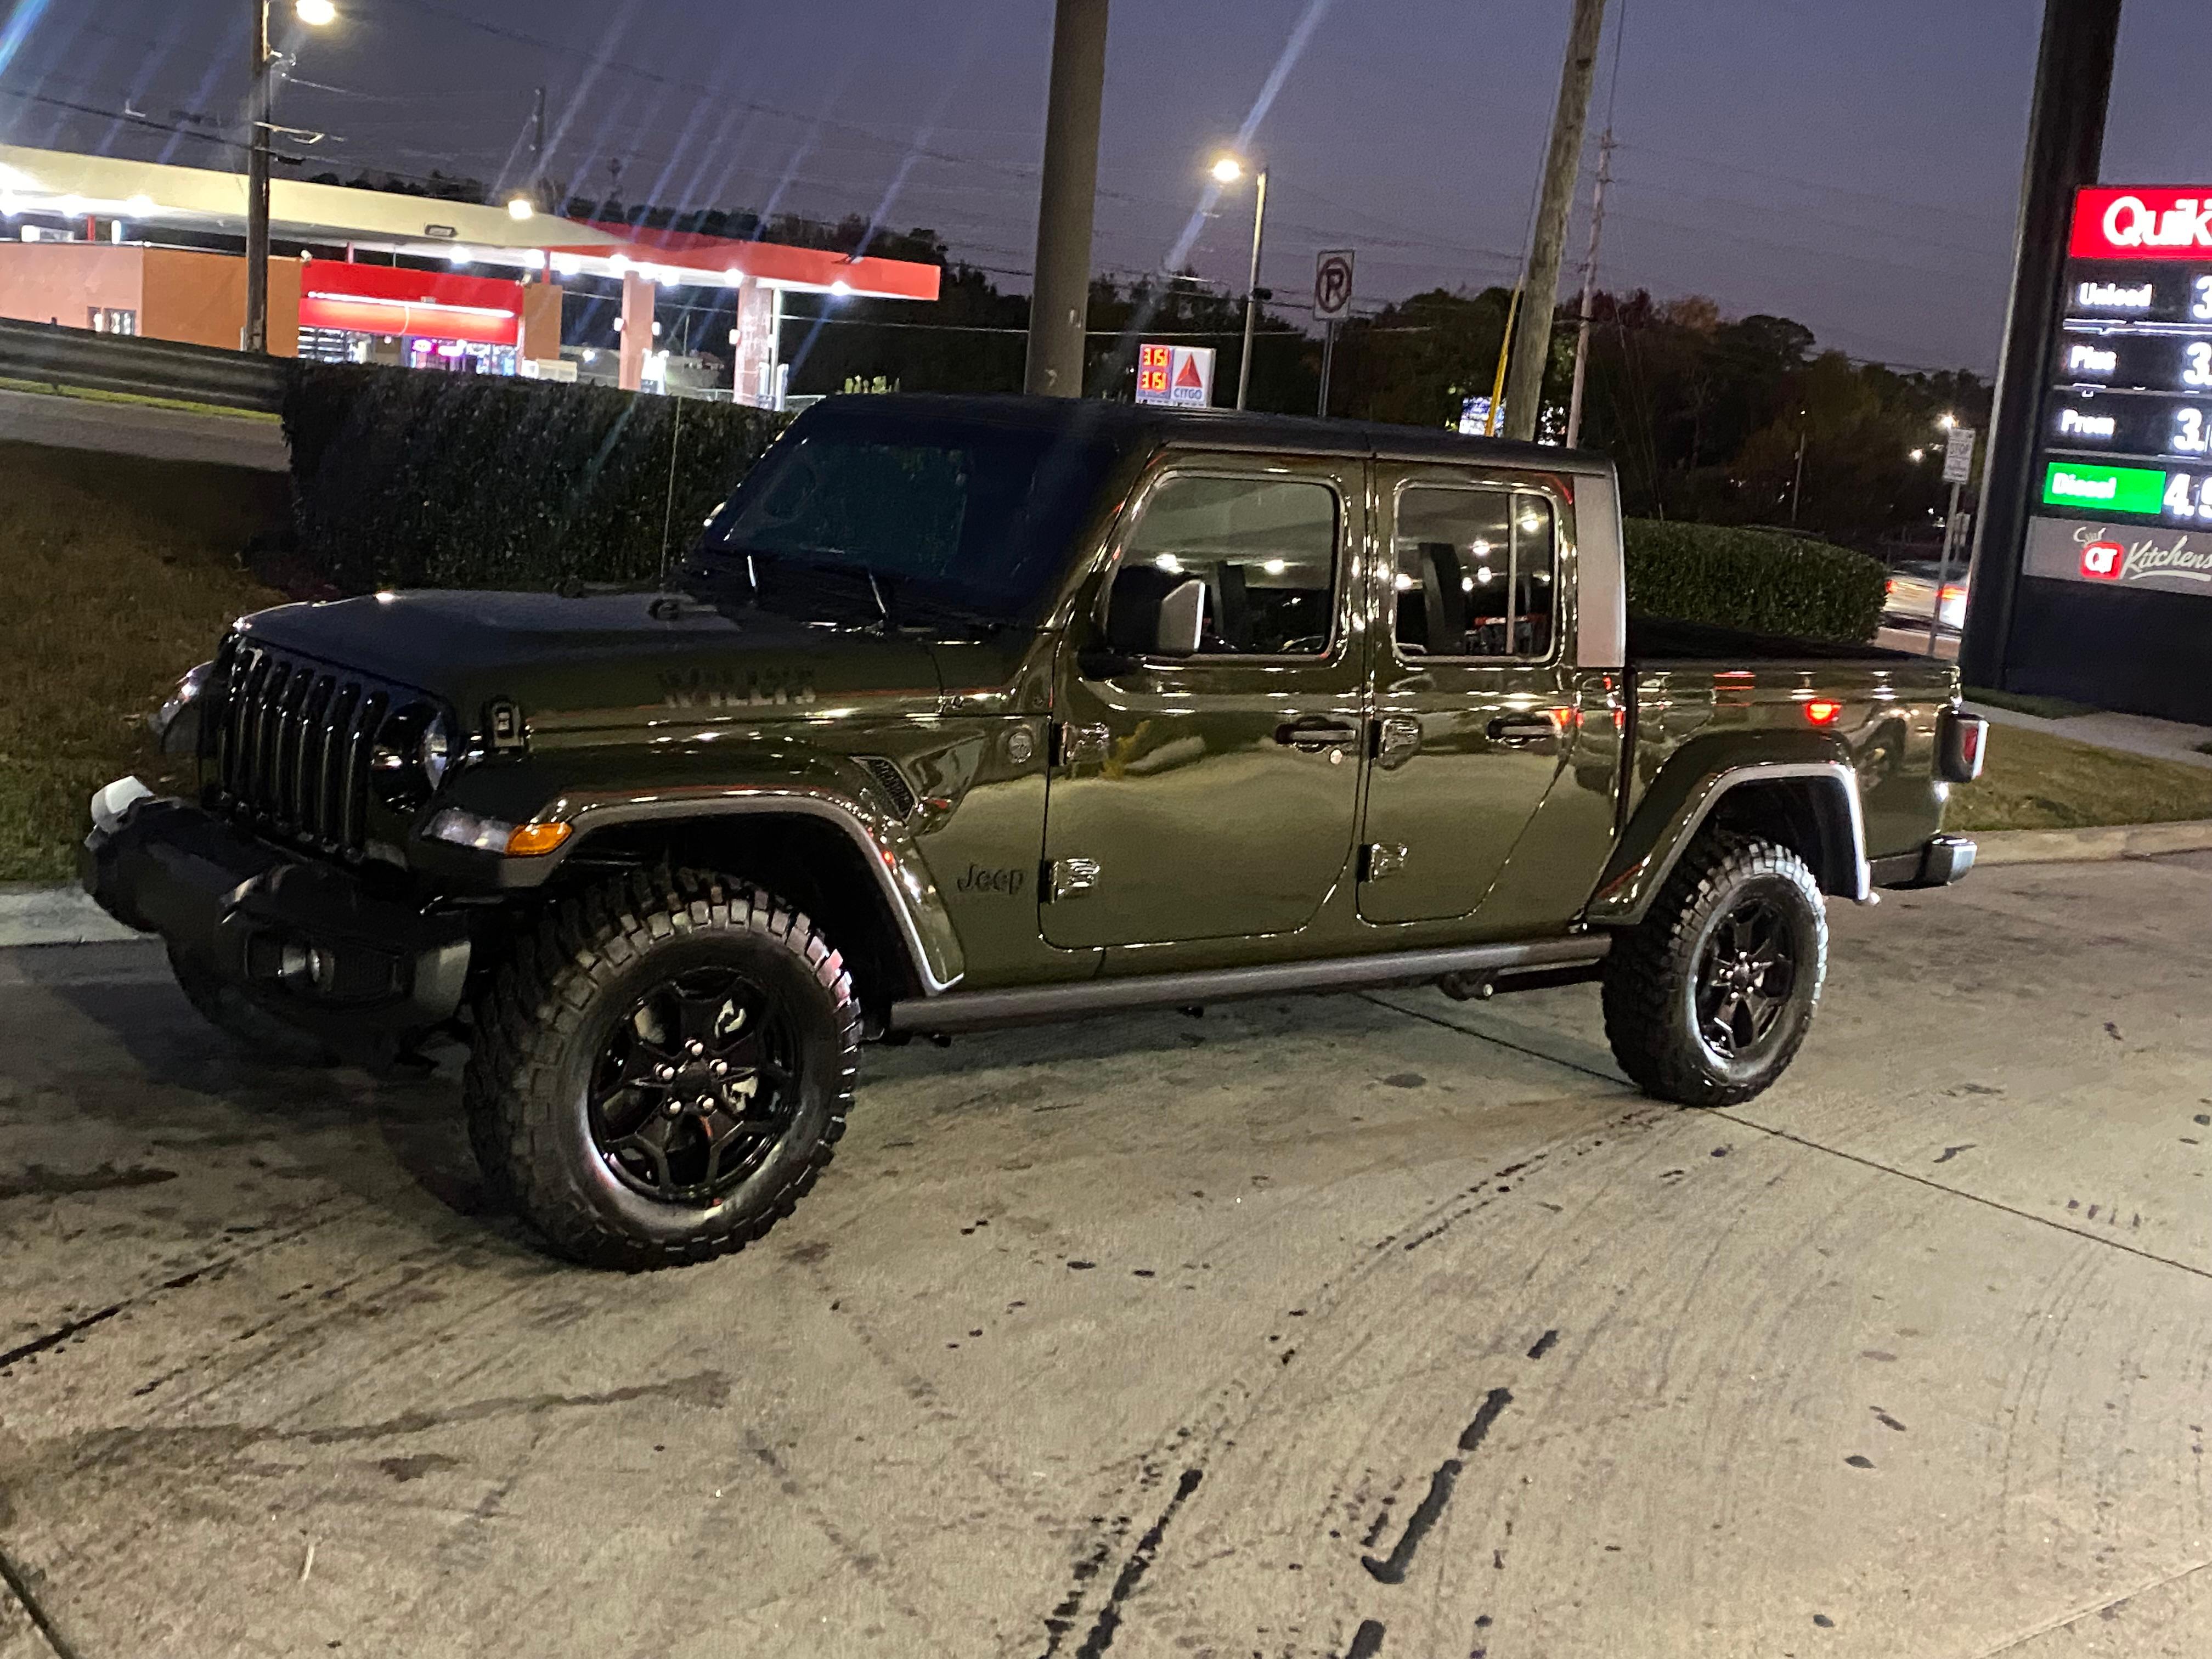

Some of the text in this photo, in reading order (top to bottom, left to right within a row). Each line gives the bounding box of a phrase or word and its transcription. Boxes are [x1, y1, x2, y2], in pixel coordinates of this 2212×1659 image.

[2103, 196, 2212, 247] Quik
[1173, 387, 1203, 399] CITGO
[2174, 408, 2212, 451] 3.
[2119, 535, 2212, 580] Kitchens
[957, 864, 1024, 895] Jeep
